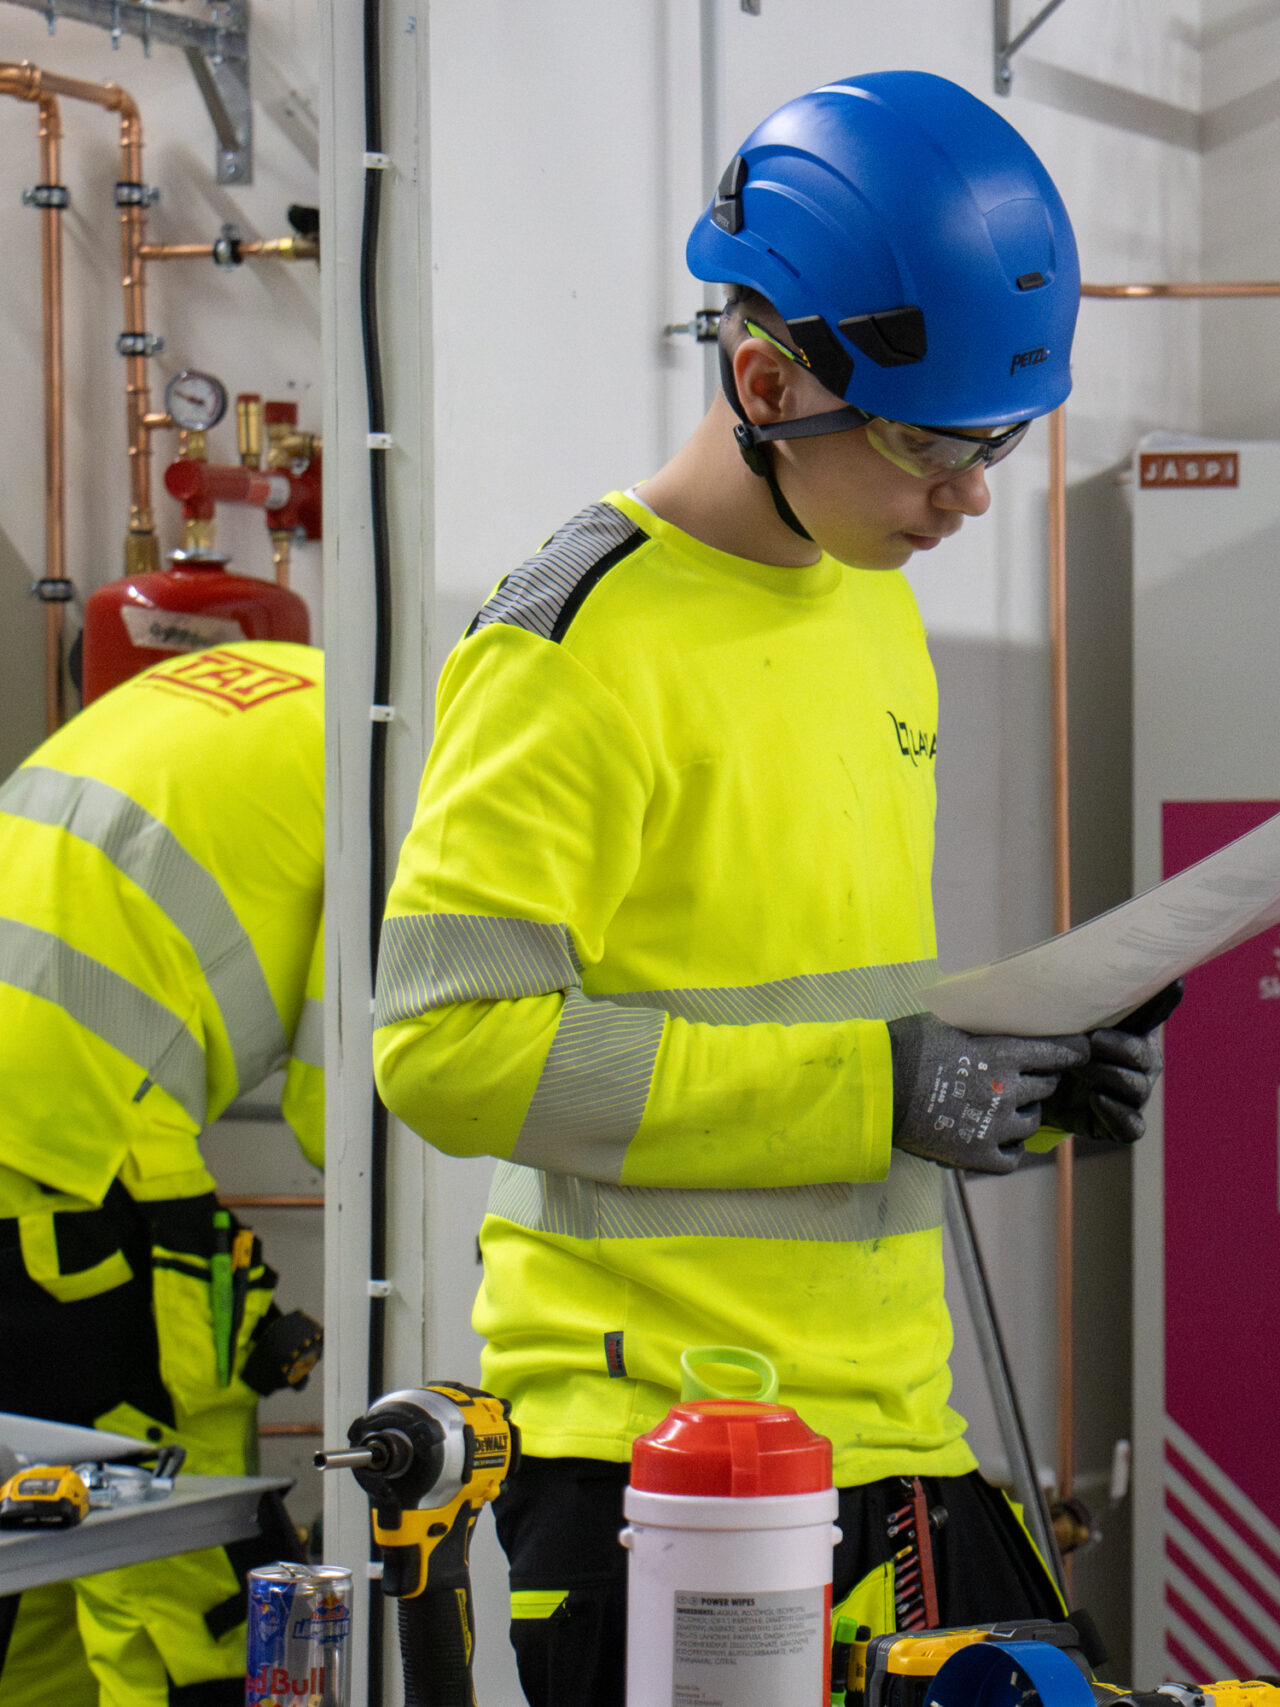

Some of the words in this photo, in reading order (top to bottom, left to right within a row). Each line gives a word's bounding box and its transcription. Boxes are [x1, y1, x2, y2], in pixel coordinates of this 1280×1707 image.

[701, 1597, 730, 1607] POWER
[731, 1597, 756, 1606] WIPES
[271, 1667, 325, 1695] Bull
